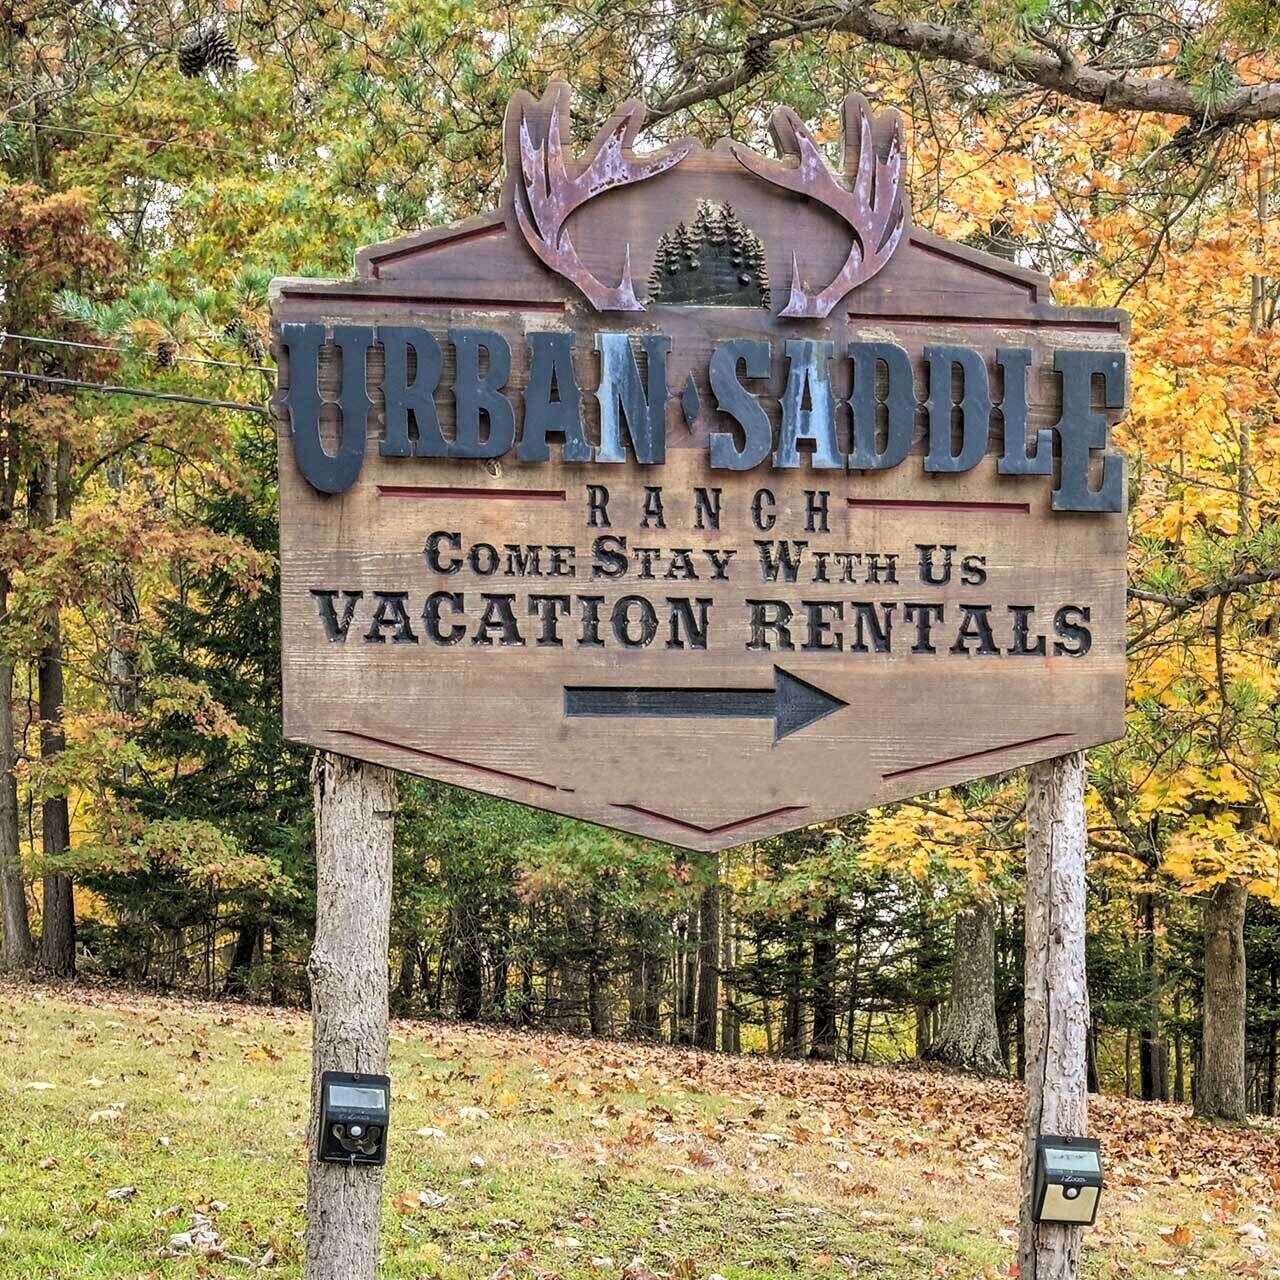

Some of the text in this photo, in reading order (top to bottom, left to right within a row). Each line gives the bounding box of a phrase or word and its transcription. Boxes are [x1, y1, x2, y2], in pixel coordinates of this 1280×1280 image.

[279, 323, 1124, 512] URBAN SADDLE
[587, 484, 831, 531] RANCH
[309, 590, 1093, 658] VACATION RENTALS
